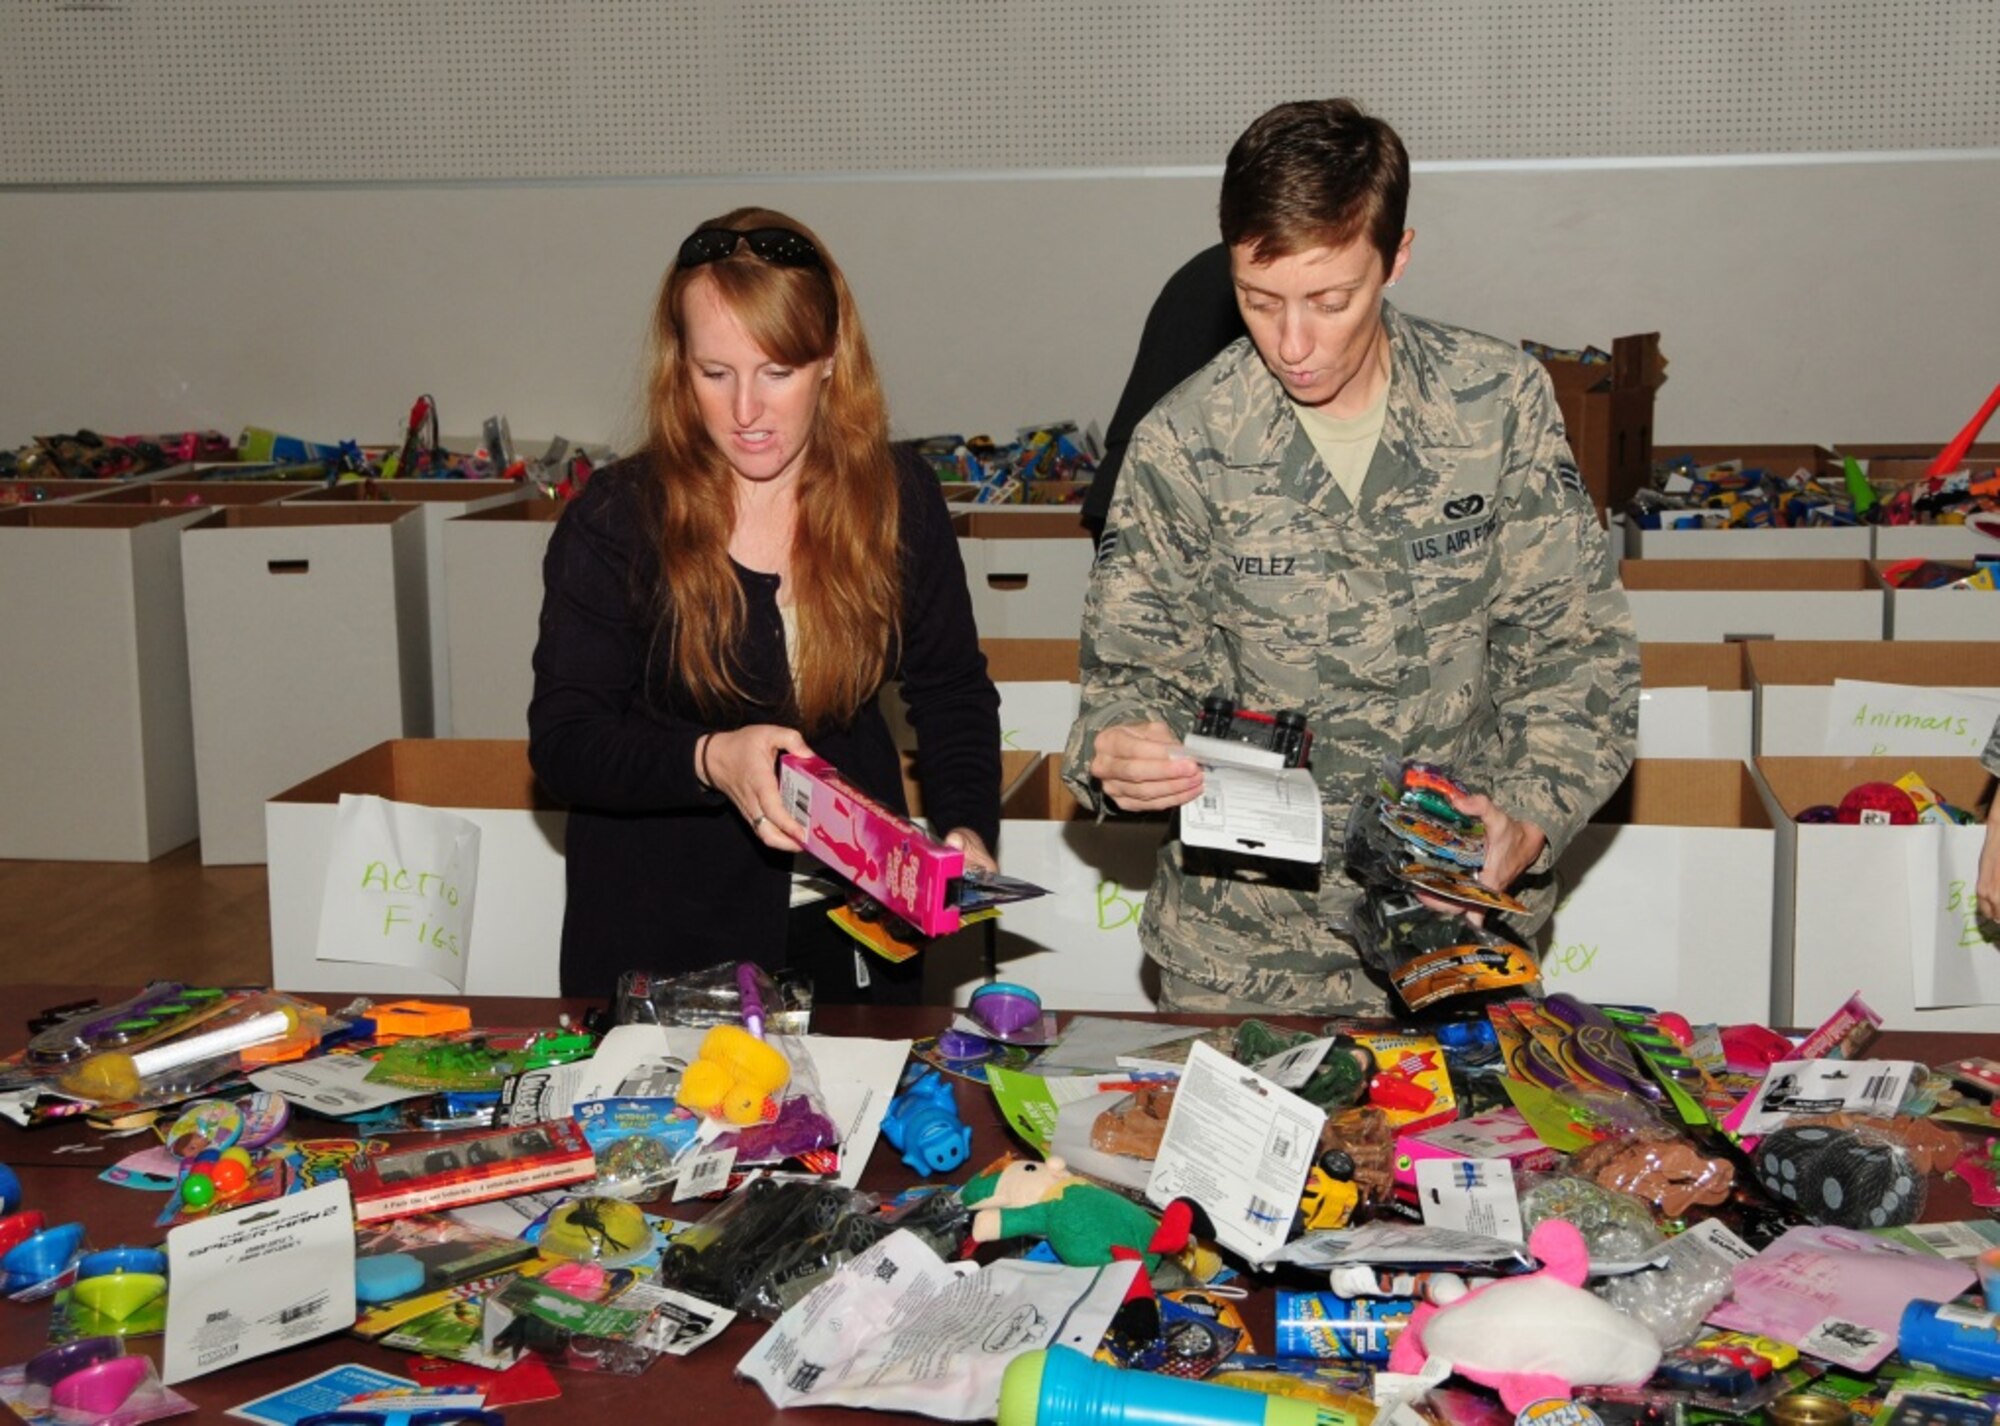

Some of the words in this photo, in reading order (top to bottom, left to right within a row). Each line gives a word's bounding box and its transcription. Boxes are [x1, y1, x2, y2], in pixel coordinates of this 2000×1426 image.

[1411, 540, 1441, 563] U.S.
[1446, 531, 1471, 556] AIR
[1232, 555, 1296, 577] VELEZ
